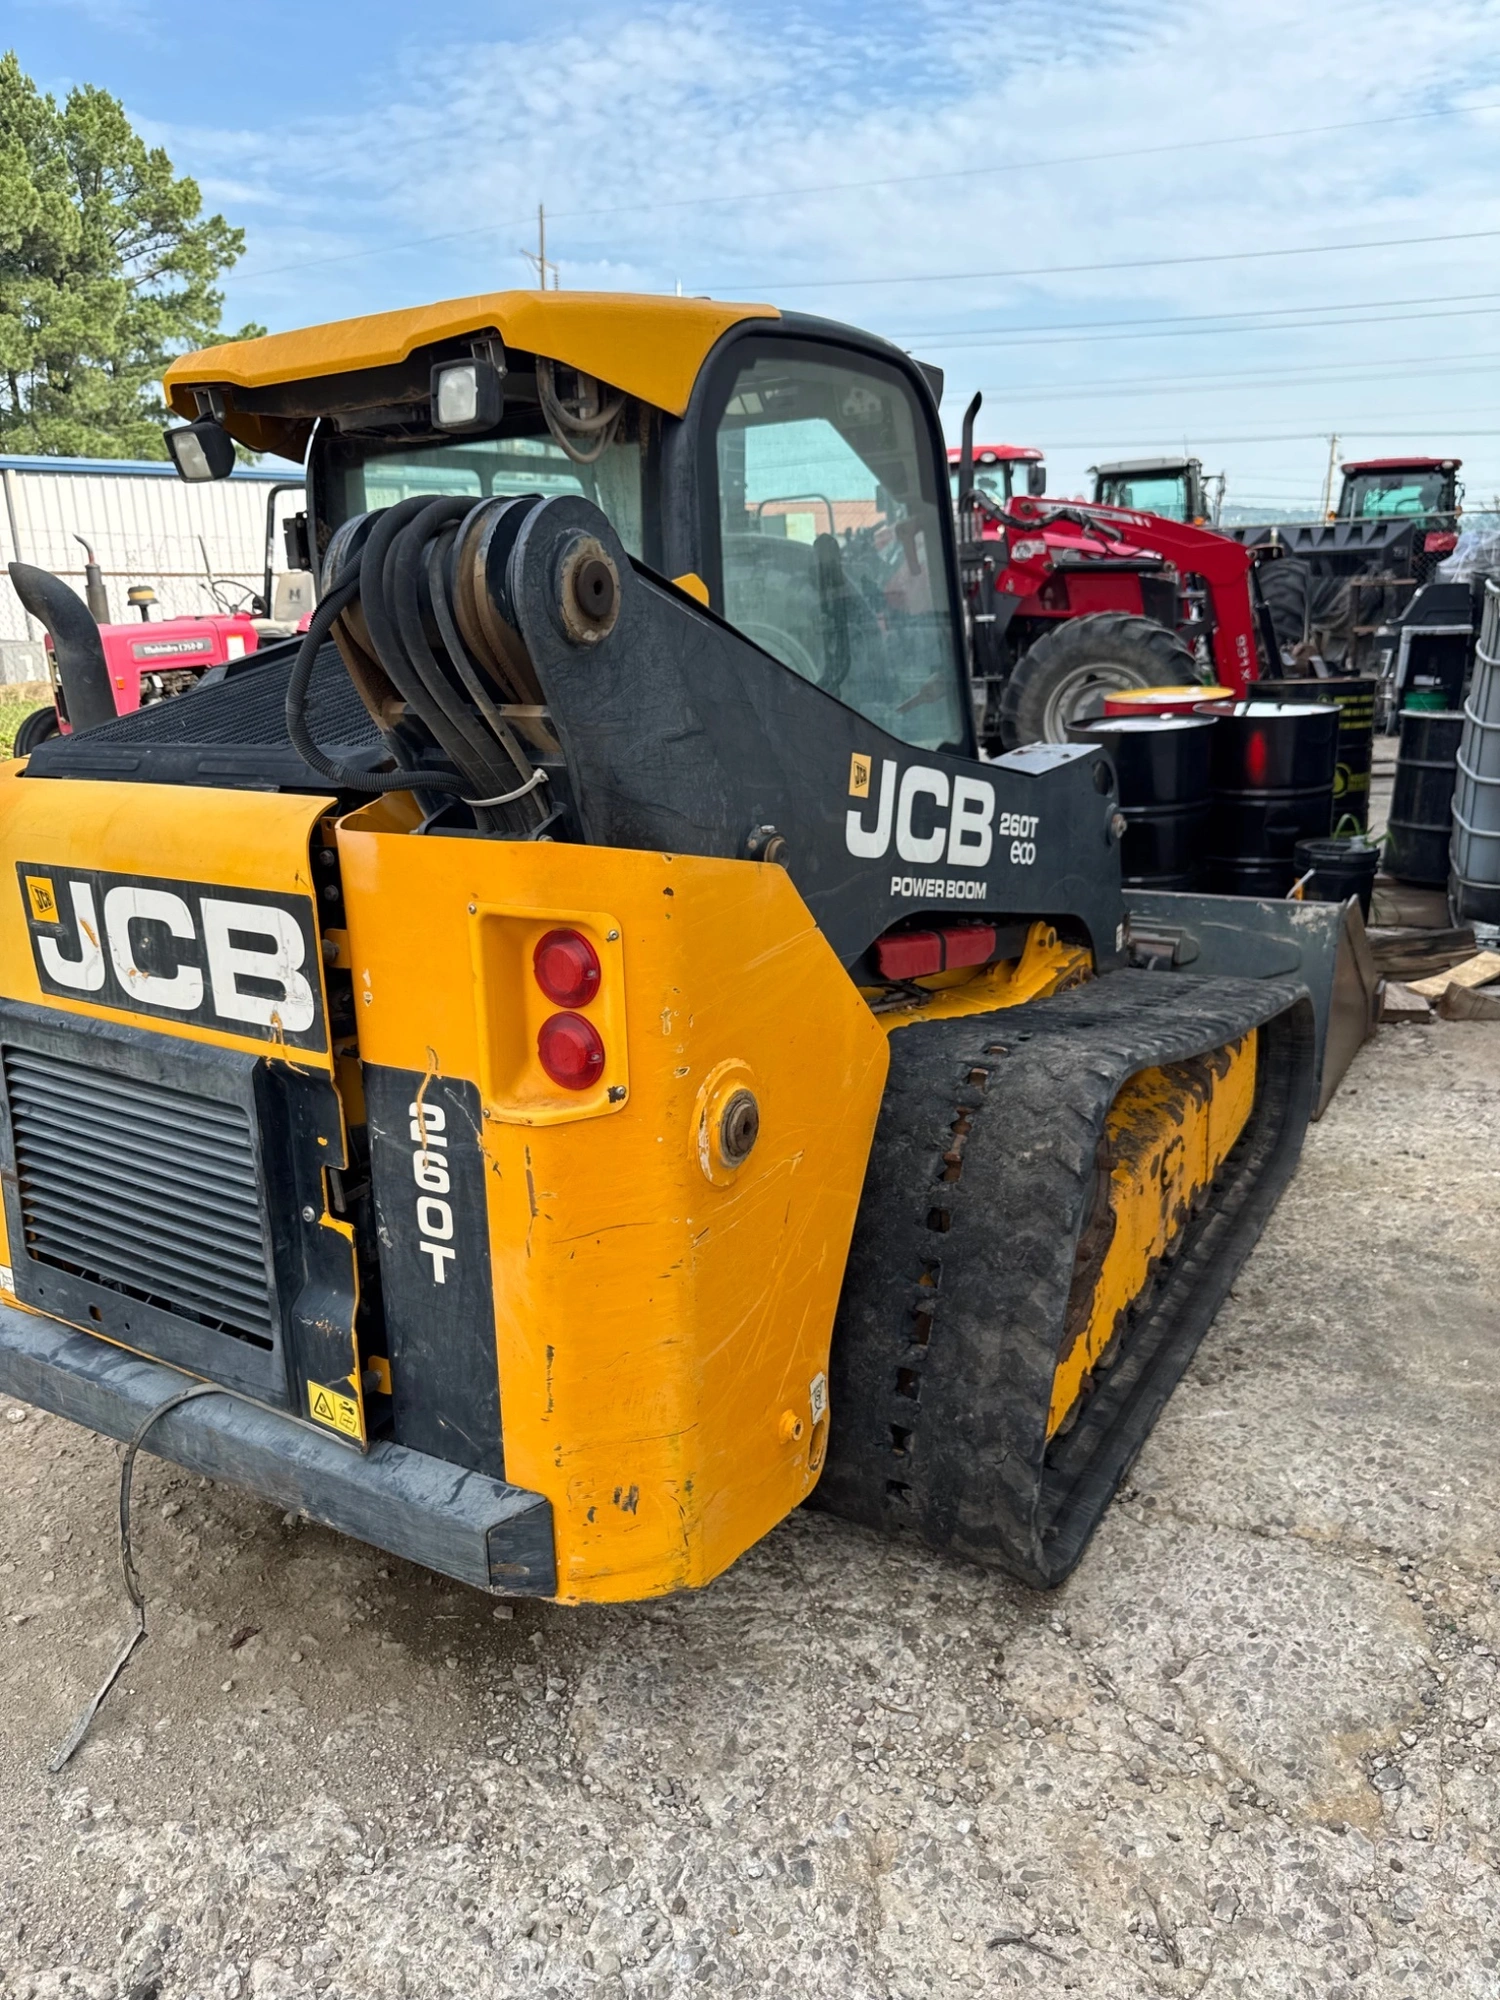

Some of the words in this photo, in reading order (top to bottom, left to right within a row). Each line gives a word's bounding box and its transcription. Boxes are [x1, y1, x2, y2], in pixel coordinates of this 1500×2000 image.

[845, 759, 996, 867] JCB
[999, 812, 1040, 838] 260T
[33, 888, 52, 910] JCB
[890, 876, 945, 898] POWER
[945, 880, 987, 900] BOOM
[37, 881, 315, 1032] JCB
[409, 1102, 456, 1284] 260T
